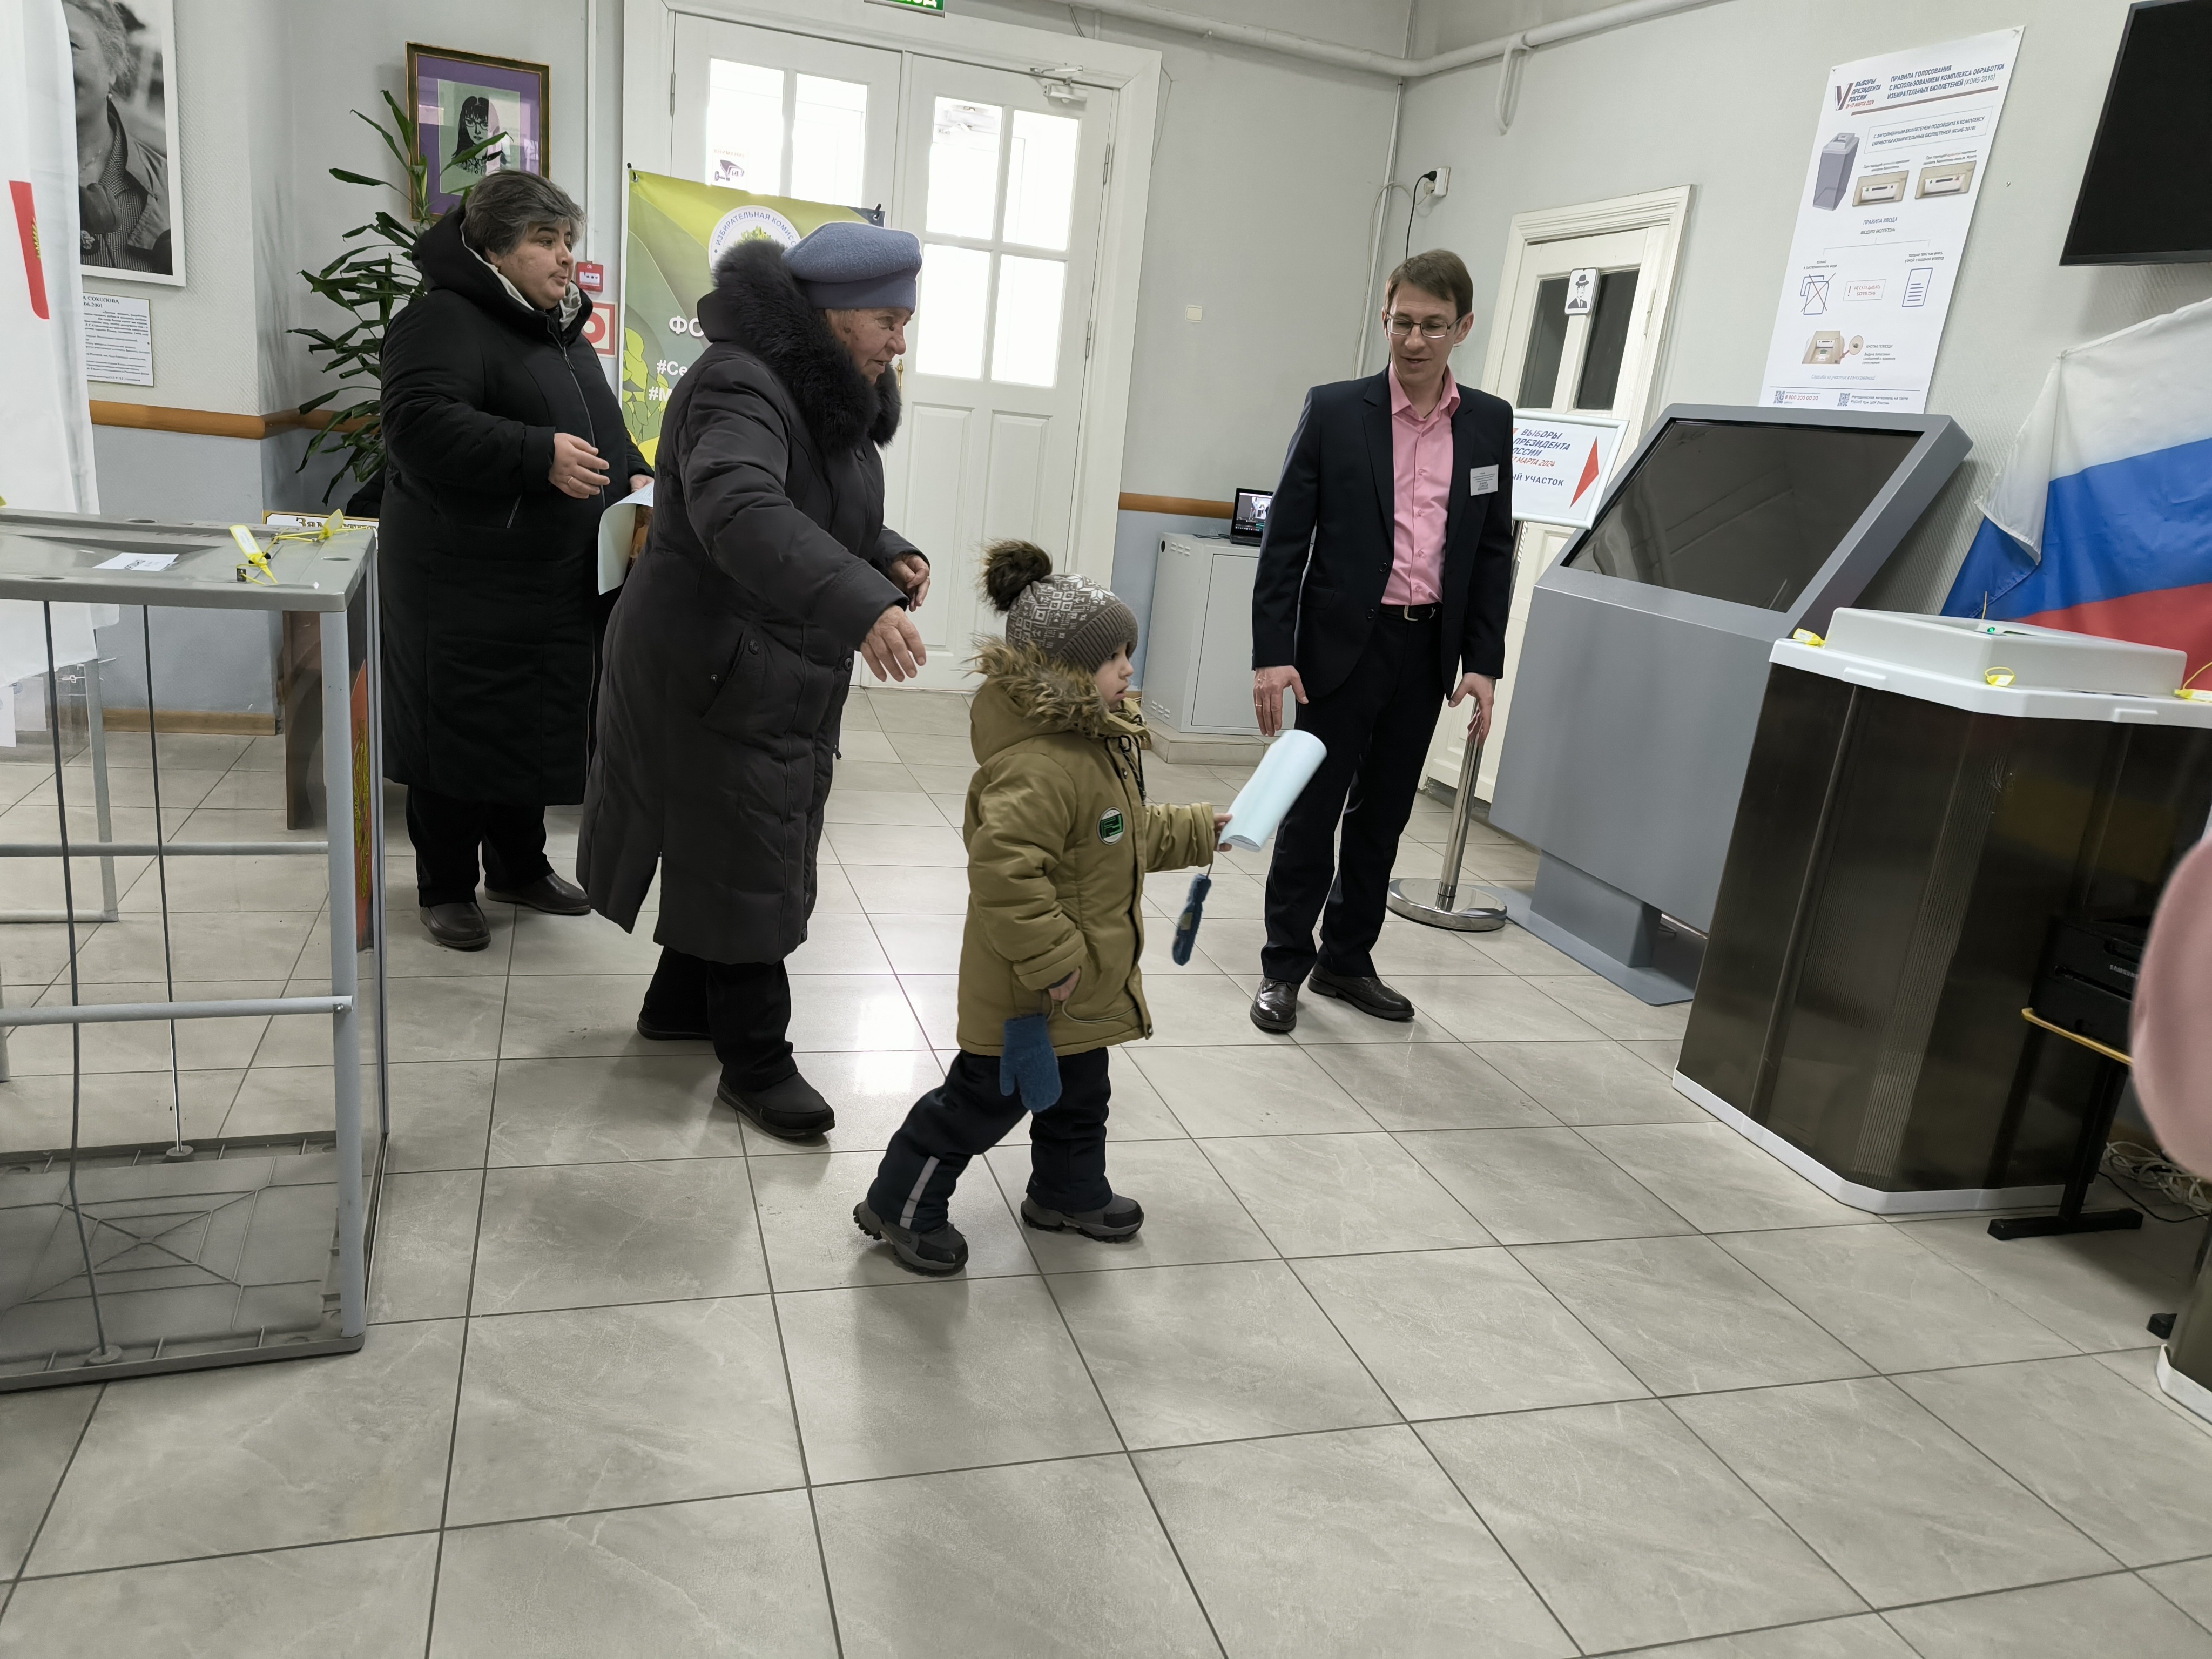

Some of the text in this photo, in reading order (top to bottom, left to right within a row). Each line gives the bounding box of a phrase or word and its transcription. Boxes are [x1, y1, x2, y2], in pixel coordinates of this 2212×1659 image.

[1891, 65, 1952, 82] ПРАВИЛА ГОЛОСОВАНИЯ
[1893, 76, 1940, 90] ИСПОЛЬЗОВАНИЕМ
[1940, 70, 1972, 82] КОМПЛЕКСА
[1973, 63, 2005, 75] ОБРАБОТКИ
[1854, 77, 1877, 87] ВЫБОРЫ
[1887, 86, 1928, 99] ИЗБИРАТЕЛЬНЫХ
[1929, 79, 1964, 92] БЮЛЛЕТЕНЕЙ
[716, 211, 797, 246] ИЗБИРАТЕЛЬНАЯ КОМИСС
[87, 296, 119, 304] СОКОЛОВА
[1520, 429, 1563, 440] ВЫБОРЫ
[1513, 437, 1571, 451] ПРЕЗИДЕНТА
[1516, 457, 1540, 466] МАРТА
[1524, 475, 1564, 487] УЧАСТОК
